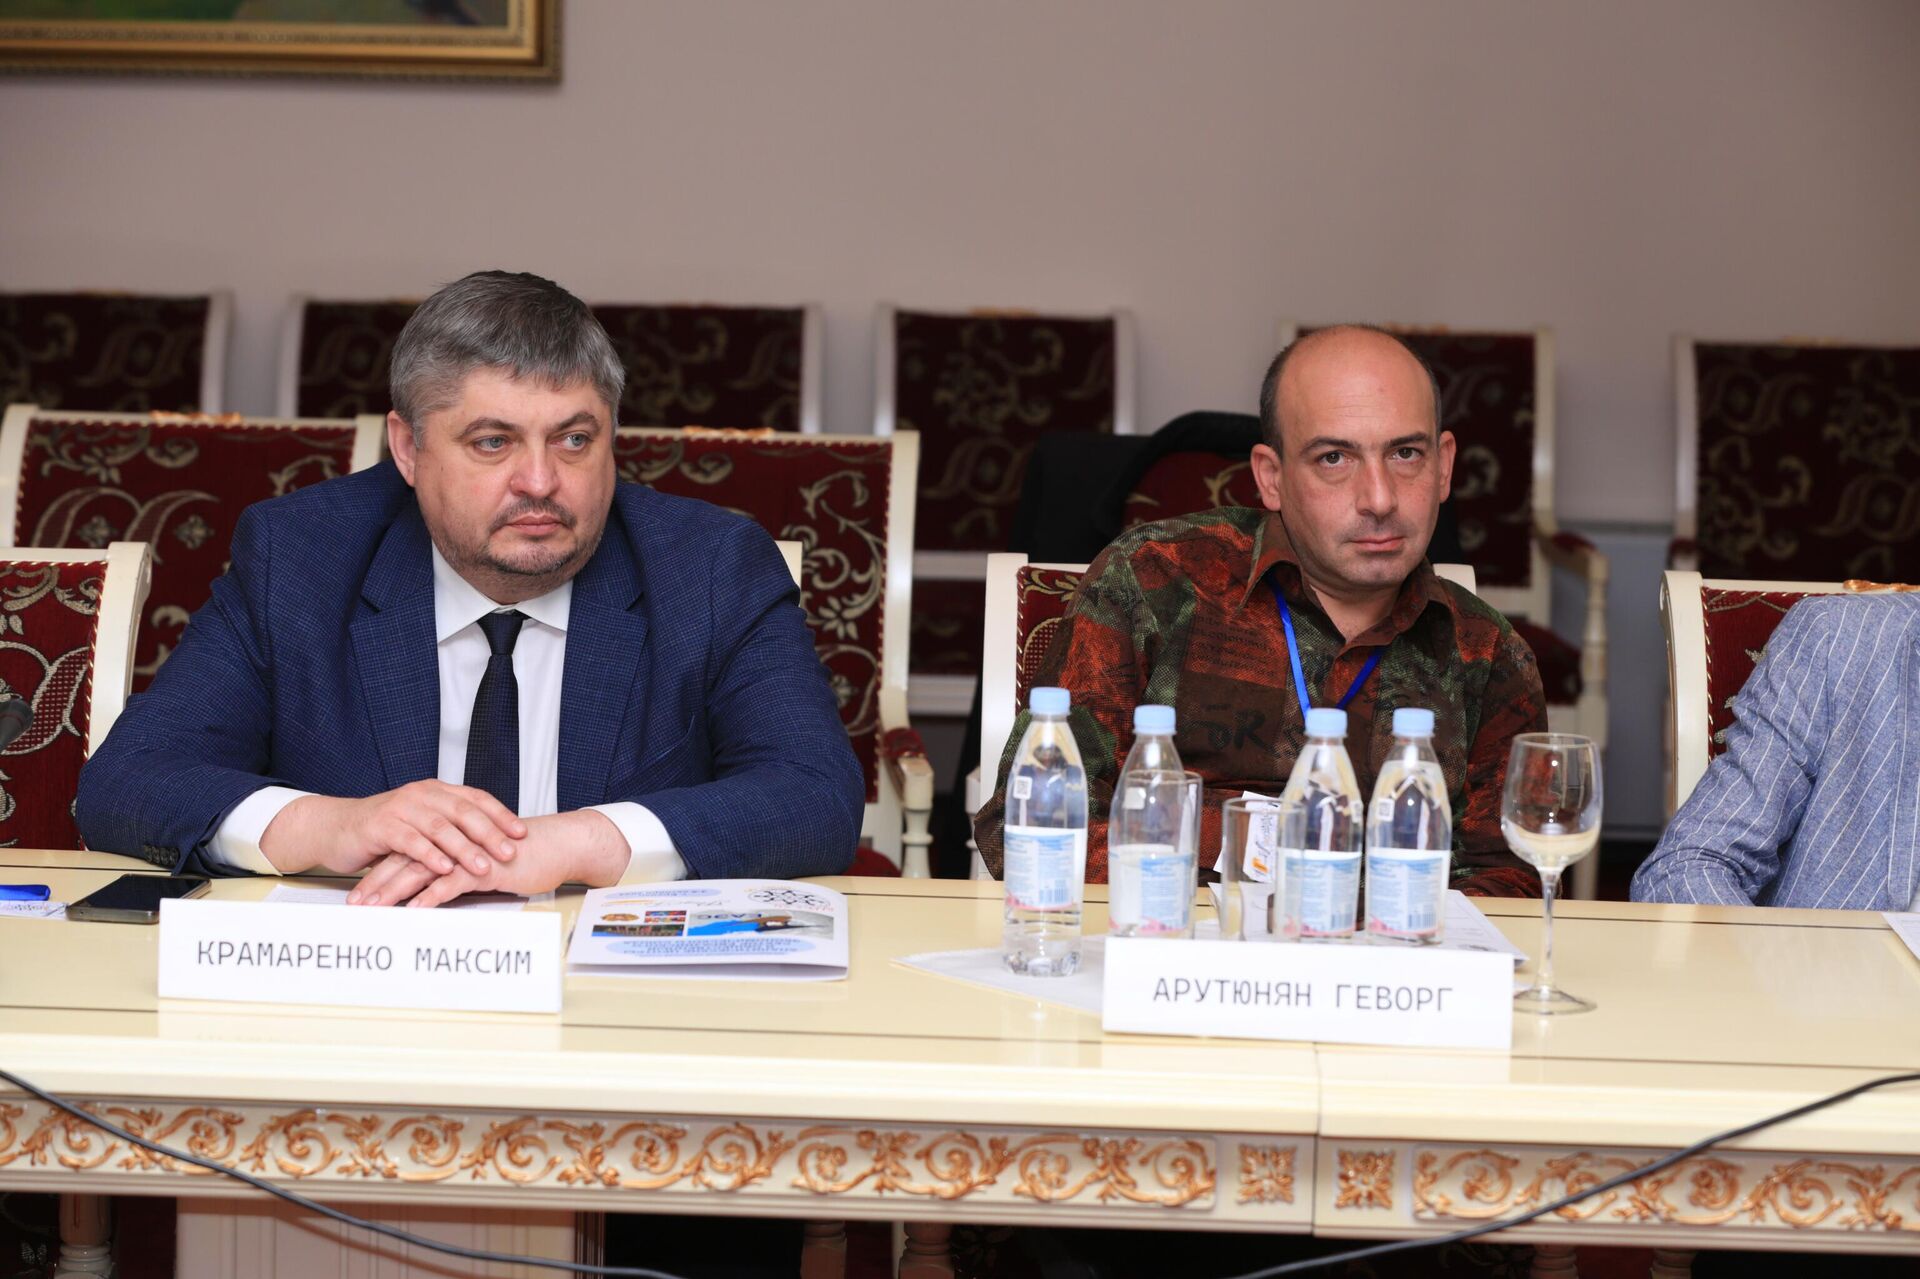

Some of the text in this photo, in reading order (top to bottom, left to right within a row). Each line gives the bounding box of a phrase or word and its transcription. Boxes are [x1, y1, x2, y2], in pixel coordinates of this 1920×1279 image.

[198, 940, 531, 975] КРАМАРЕНКО МАКСИМ
[1153, 977, 1453, 1012] АРУТЮНЯН ГЕВОРГ
